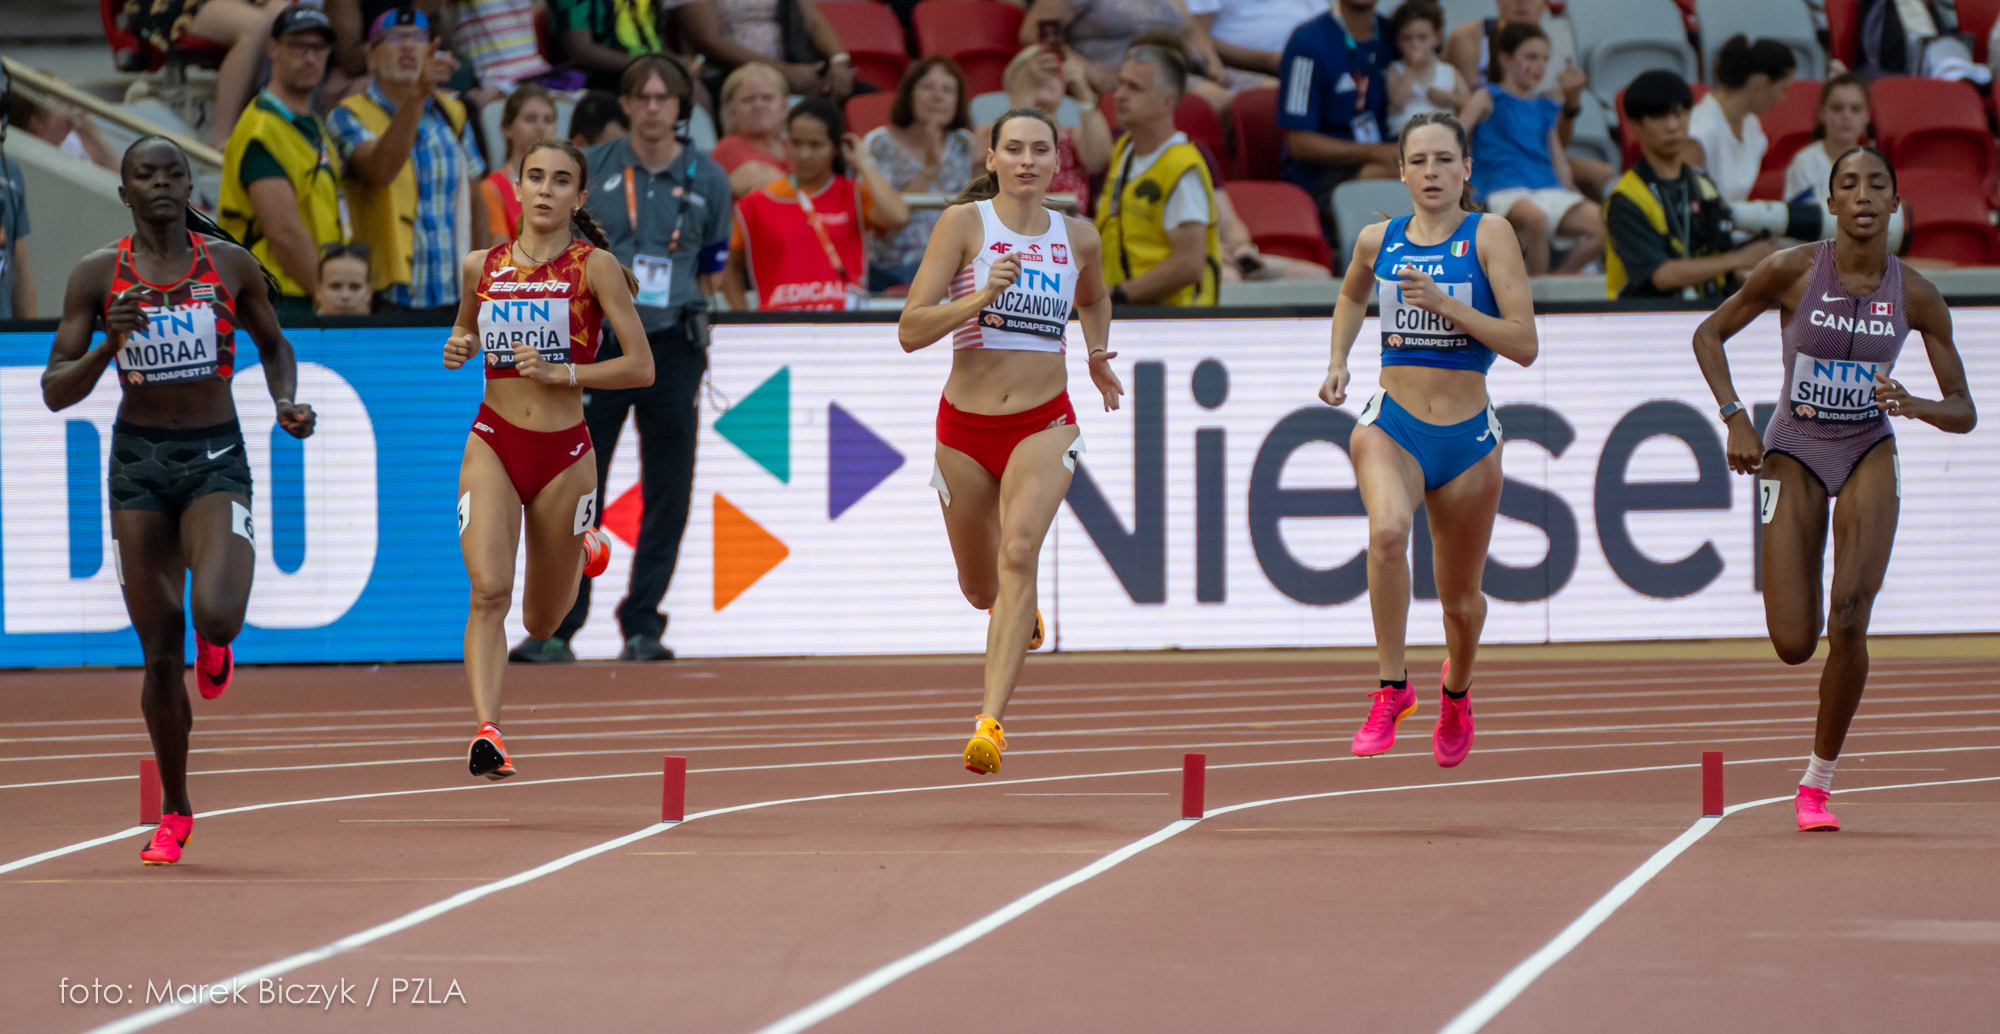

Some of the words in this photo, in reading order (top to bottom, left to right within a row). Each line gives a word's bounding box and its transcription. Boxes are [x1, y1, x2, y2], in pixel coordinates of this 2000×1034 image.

[990, 242, 1013, 254] 4F
[488, 280, 571, 293] ESPAÑA
[492, 300, 550, 323] NTN
[986, 291, 1067, 320] OCZANOWA
[1006, 319, 1056, 333] BUDAPEST
[1810, 310, 1896, 337] CANADA
[486, 326, 561, 350] GARCÍA
[1405, 337, 1455, 347] BUDAPEST
[1456, 338, 1468, 346] 23
[125, 338, 208, 367] MORAA
[552, 352, 564, 361] 23
[146, 368, 200, 382] BUDAPEST
[1813, 359, 1877, 384] NTN
[1797, 381, 1878, 408] SHUKLA
[1818, 411, 1868, 420] BUDAPEST
[1868, 409, 1879, 417] 23
[1761, 486, 1771, 516] 2
[581, 499, 593, 527] 5
